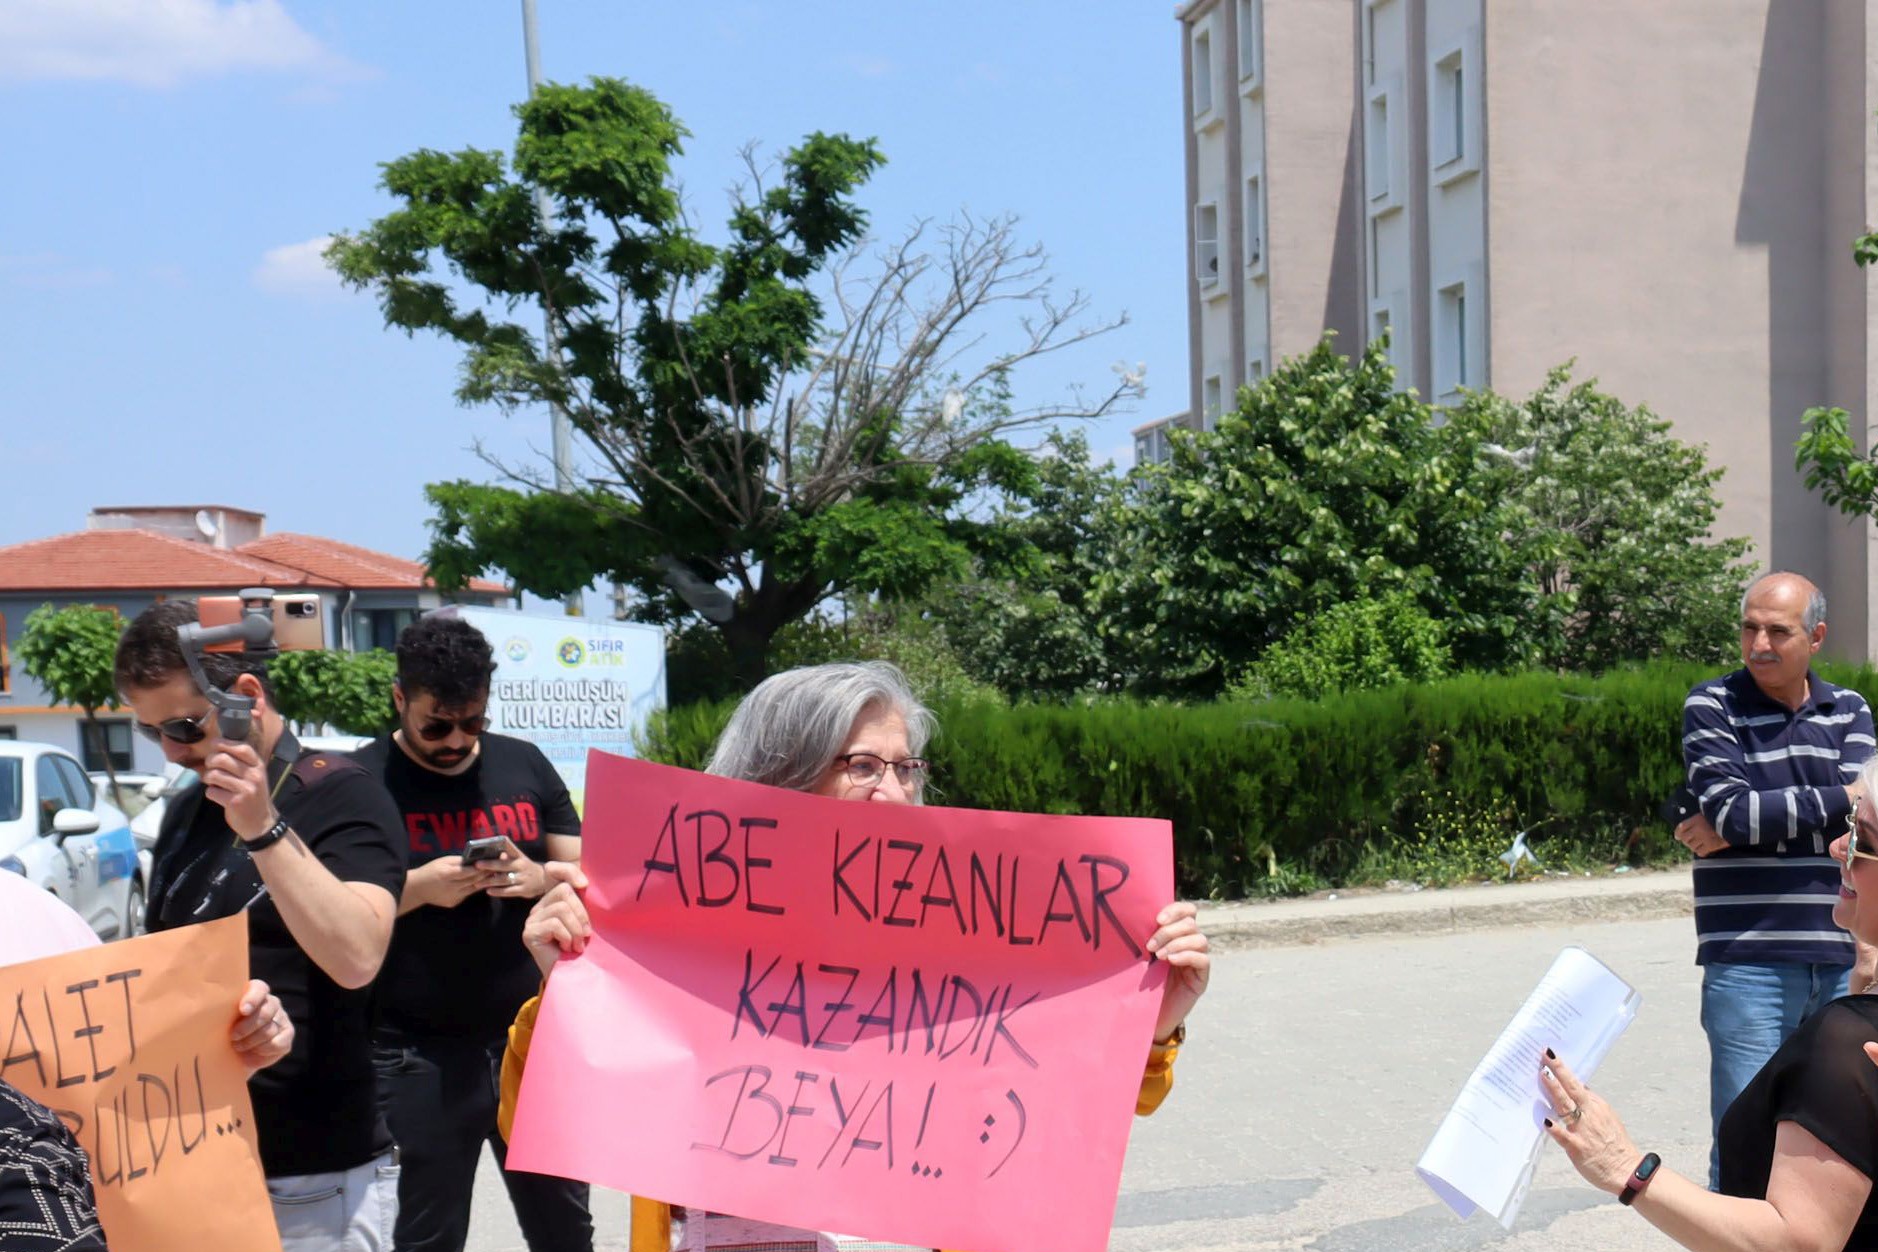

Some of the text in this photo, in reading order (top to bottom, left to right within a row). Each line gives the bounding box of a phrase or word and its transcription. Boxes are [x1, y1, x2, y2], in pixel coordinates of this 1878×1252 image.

[588, 640, 624, 652] SIFIR
[500, 677, 538, 701] GERİ
[502, 702, 625, 729] KUMBARASI
[636, 802, 785, 916] ABE
[729, 947, 1041, 1070] KAZANDIK
